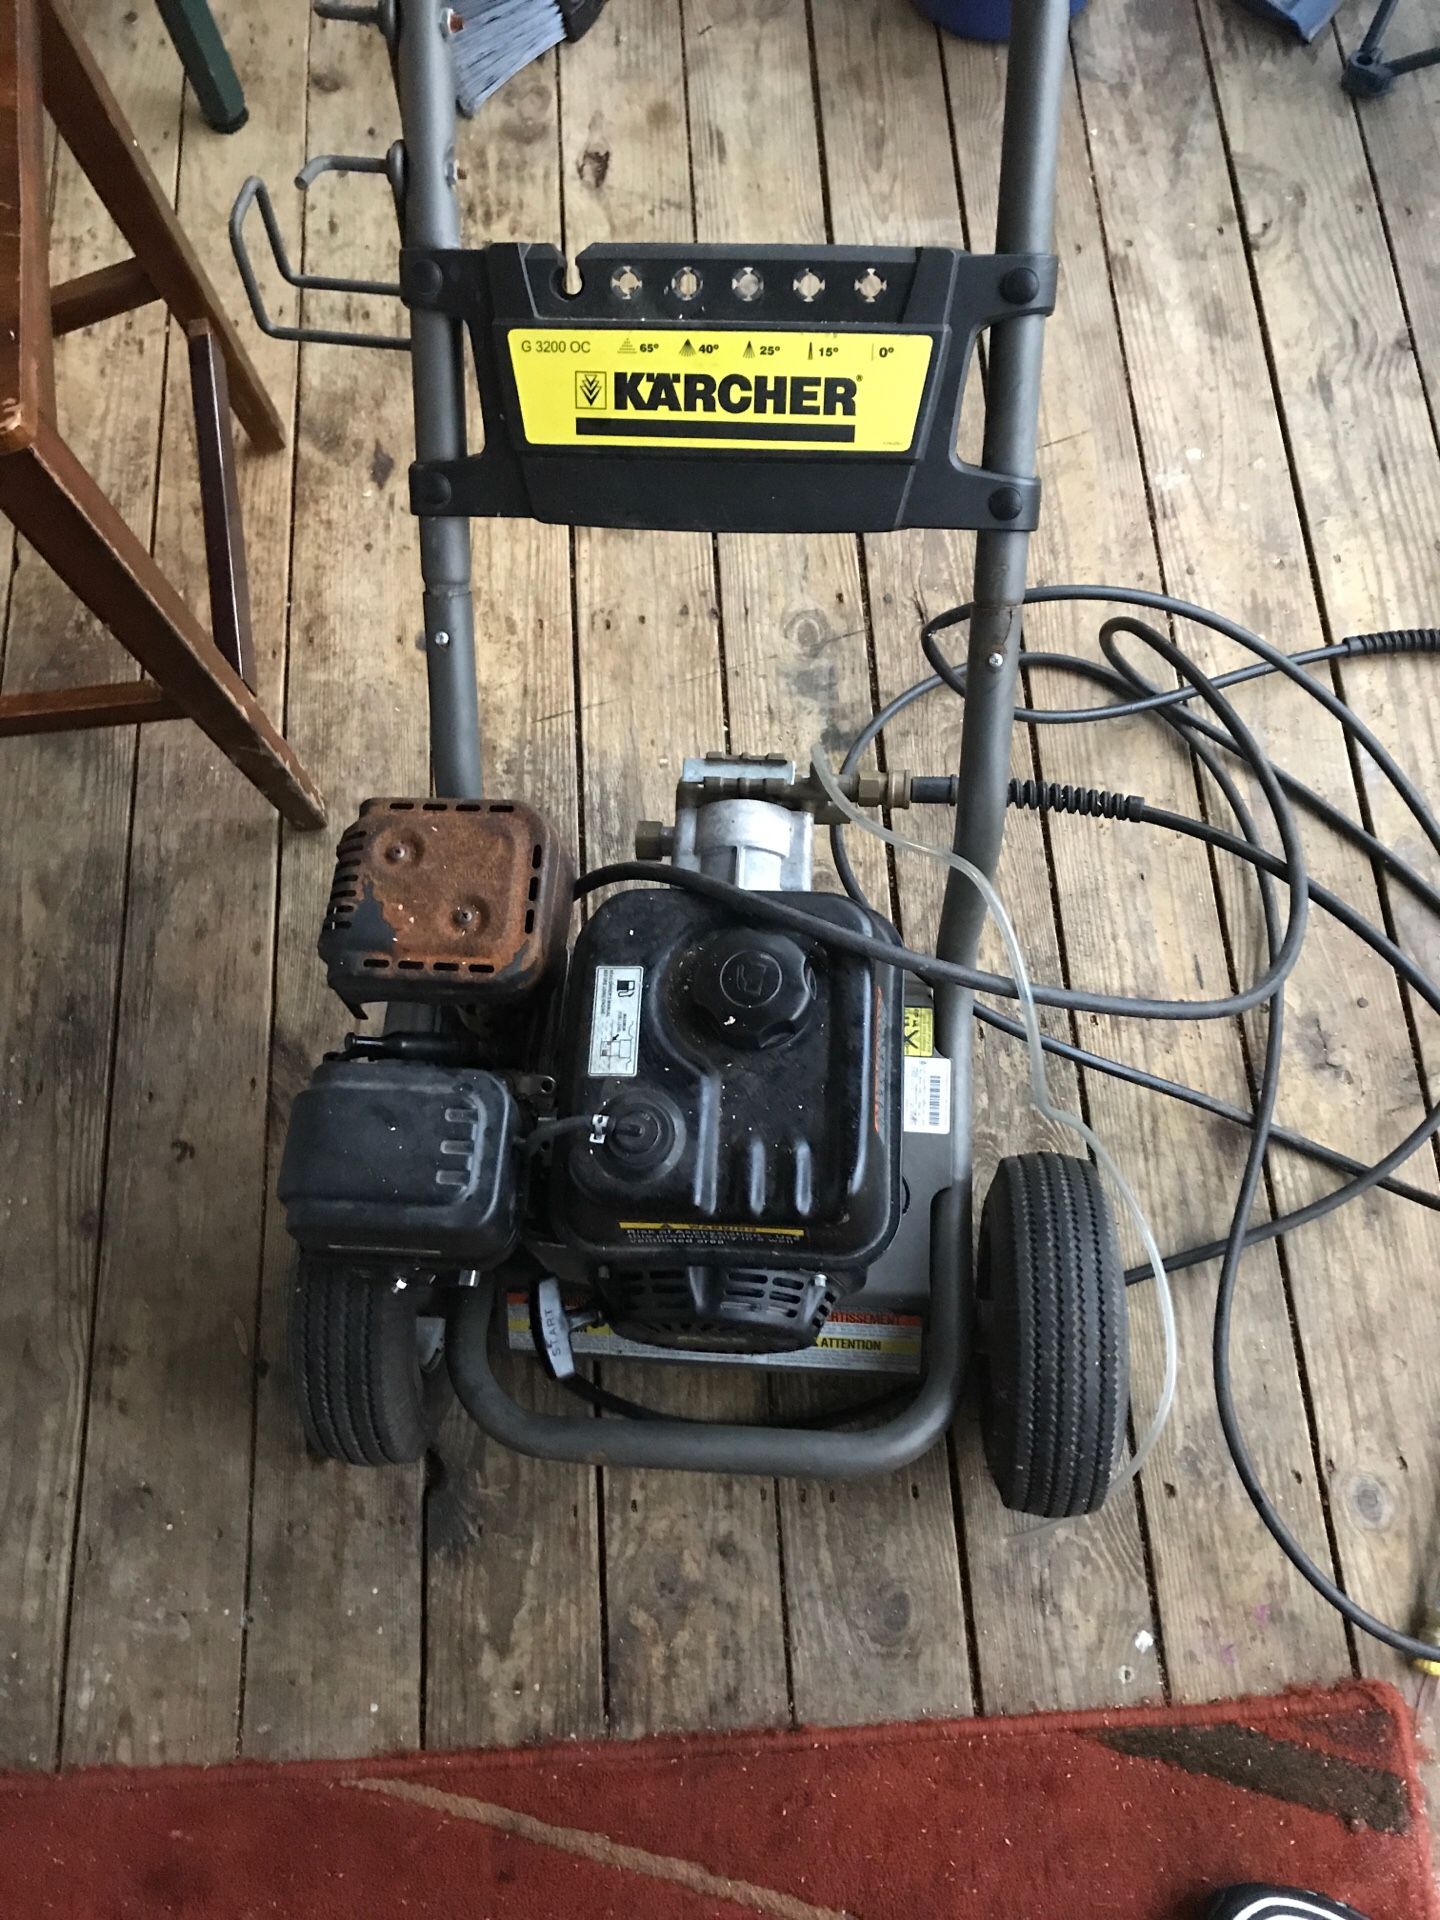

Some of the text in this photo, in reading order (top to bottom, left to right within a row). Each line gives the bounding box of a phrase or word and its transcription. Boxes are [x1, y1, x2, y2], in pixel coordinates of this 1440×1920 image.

[521, 340, 591, 353] G 3200 OC
[545, 1308, 560, 1356] START
[821, 1338, 881, 1350] ATTENTION
